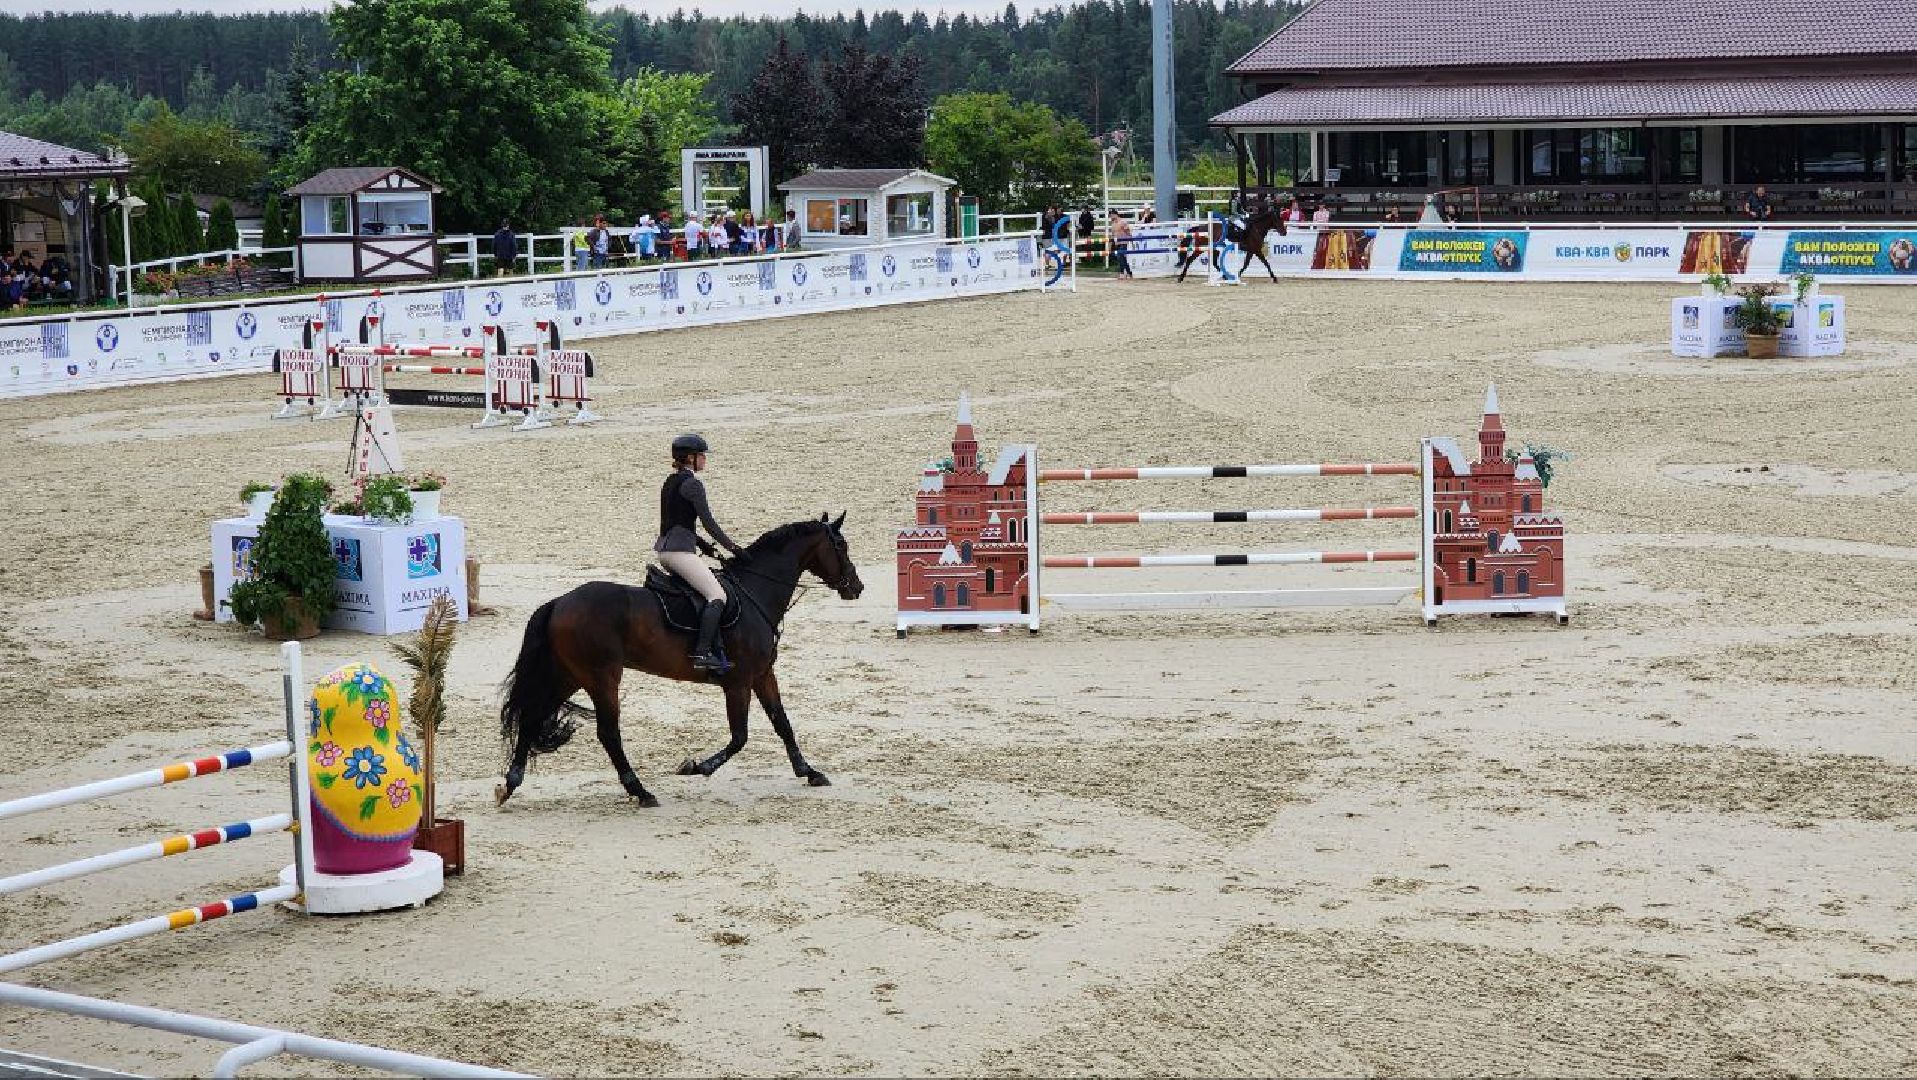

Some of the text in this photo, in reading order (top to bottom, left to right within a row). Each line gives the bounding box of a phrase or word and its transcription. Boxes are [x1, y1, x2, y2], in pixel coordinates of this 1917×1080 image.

[1273, 244, 1304, 256] ПАРК
[1411, 240, 1486, 251] ВАМ ПОЛОЖЕН
[1795, 242, 1881, 253] ВАМ ПОЛОЖЕН
[1416, 252, 1482, 263] АКВАОТПУСК
[1555, 246, 1670, 258] КВА-КВА ПАРК
[1800, 254, 1876, 266] АКВАОТПУСК
[401, 586, 451, 603] MAXIMA
